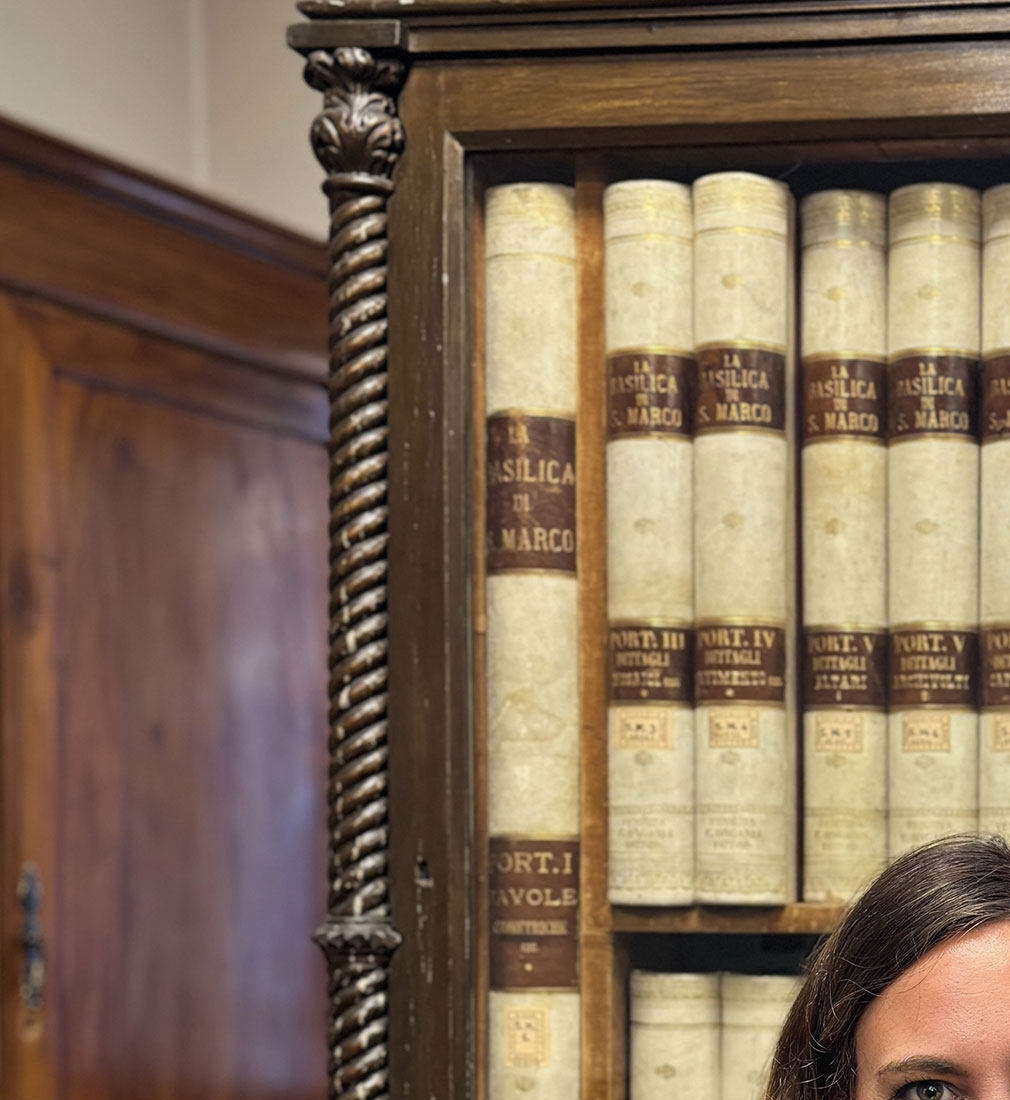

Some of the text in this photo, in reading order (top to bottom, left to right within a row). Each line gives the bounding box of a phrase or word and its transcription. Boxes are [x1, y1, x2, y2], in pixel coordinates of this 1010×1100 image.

[634, 360, 650, 374] LA
[723, 353, 740, 368] LA
[919, 362, 936, 376] LA
[831, 366, 849, 380] LA
[627, 407, 682, 427] MARCO
[715, 402, 771, 423] MARCO
[824, 411, 879, 432] MARCO
[914, 410, 969, 430] MARCO
[502, 527, 574, 553] MARCO
